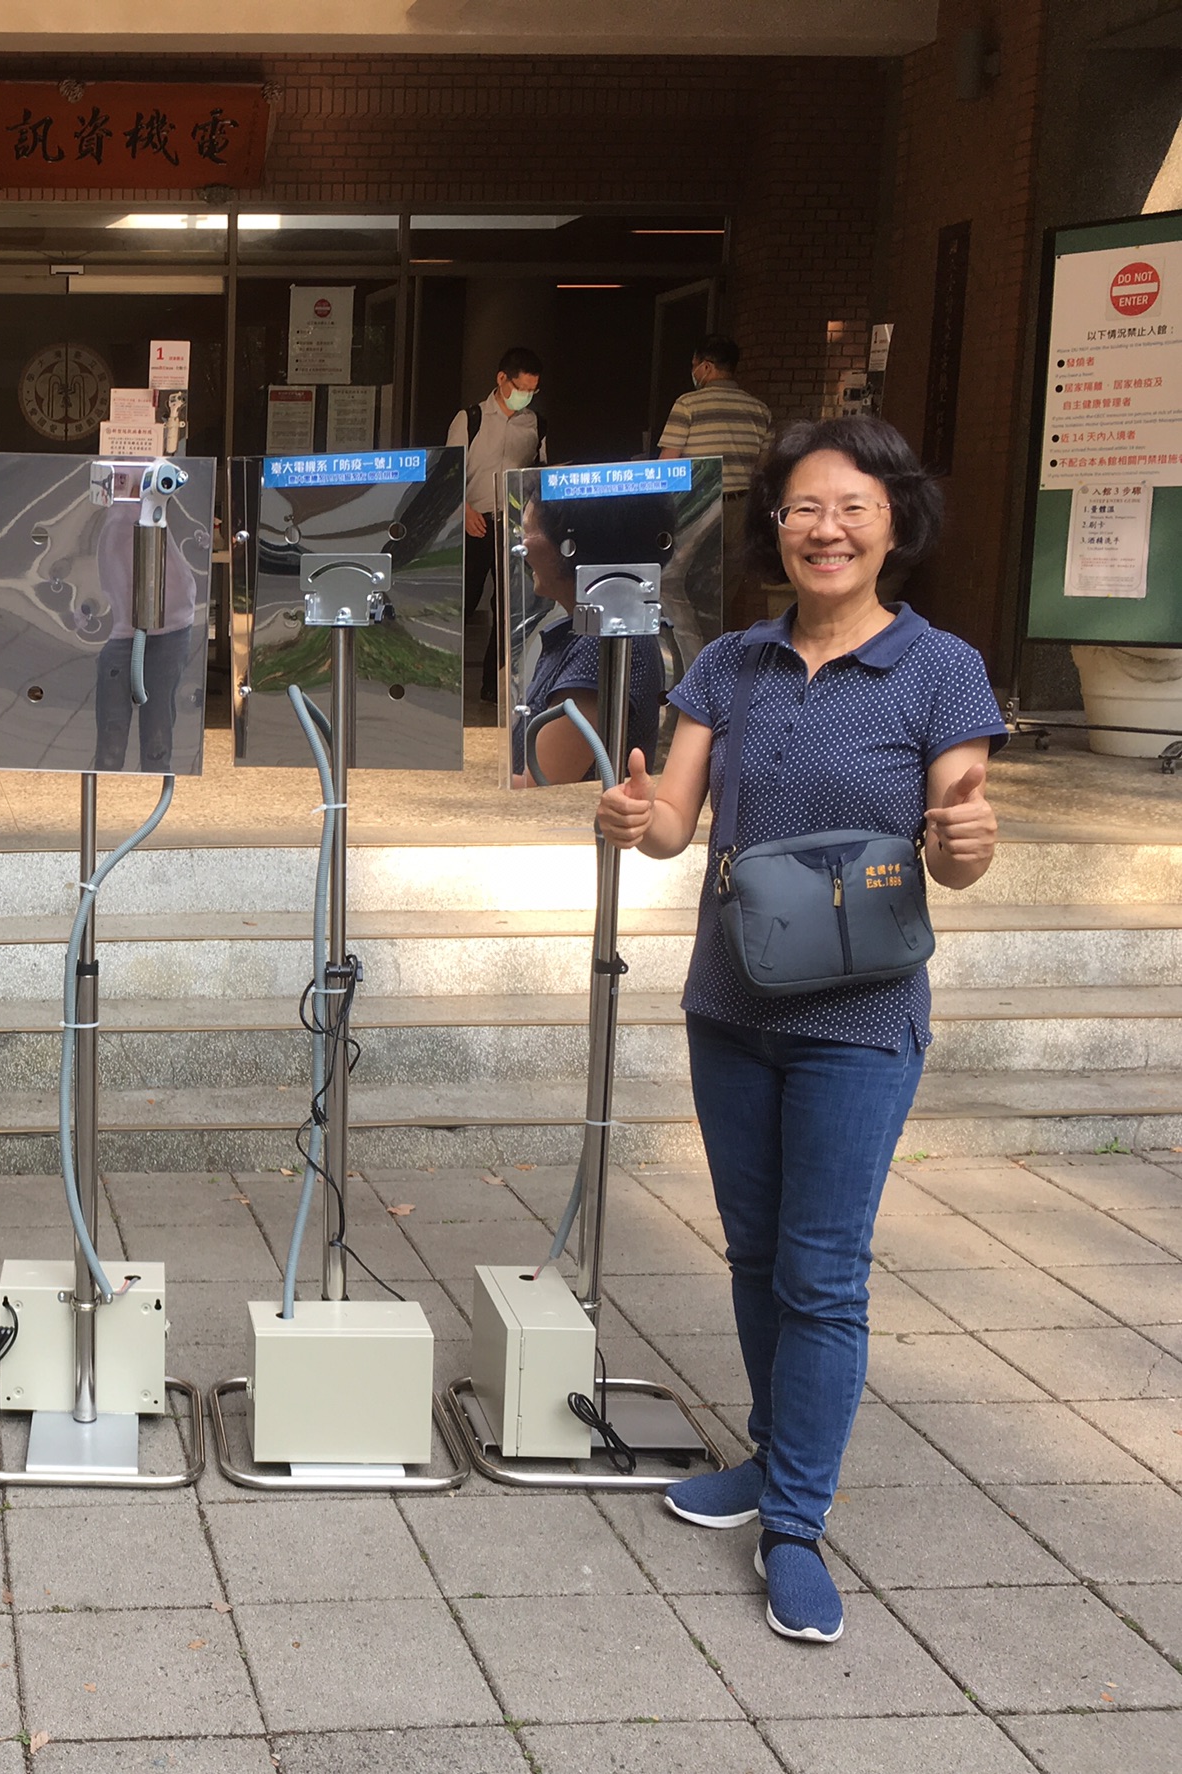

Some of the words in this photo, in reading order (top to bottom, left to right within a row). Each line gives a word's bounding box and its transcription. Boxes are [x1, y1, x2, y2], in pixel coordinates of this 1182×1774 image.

[1118, 274, 1131, 284] DO
[1134, 272, 1153, 282] NOT
[1119, 296, 1148, 307] ENTER
[156, 347, 164, 360] 1
[1073, 433, 1084, 442] 14
